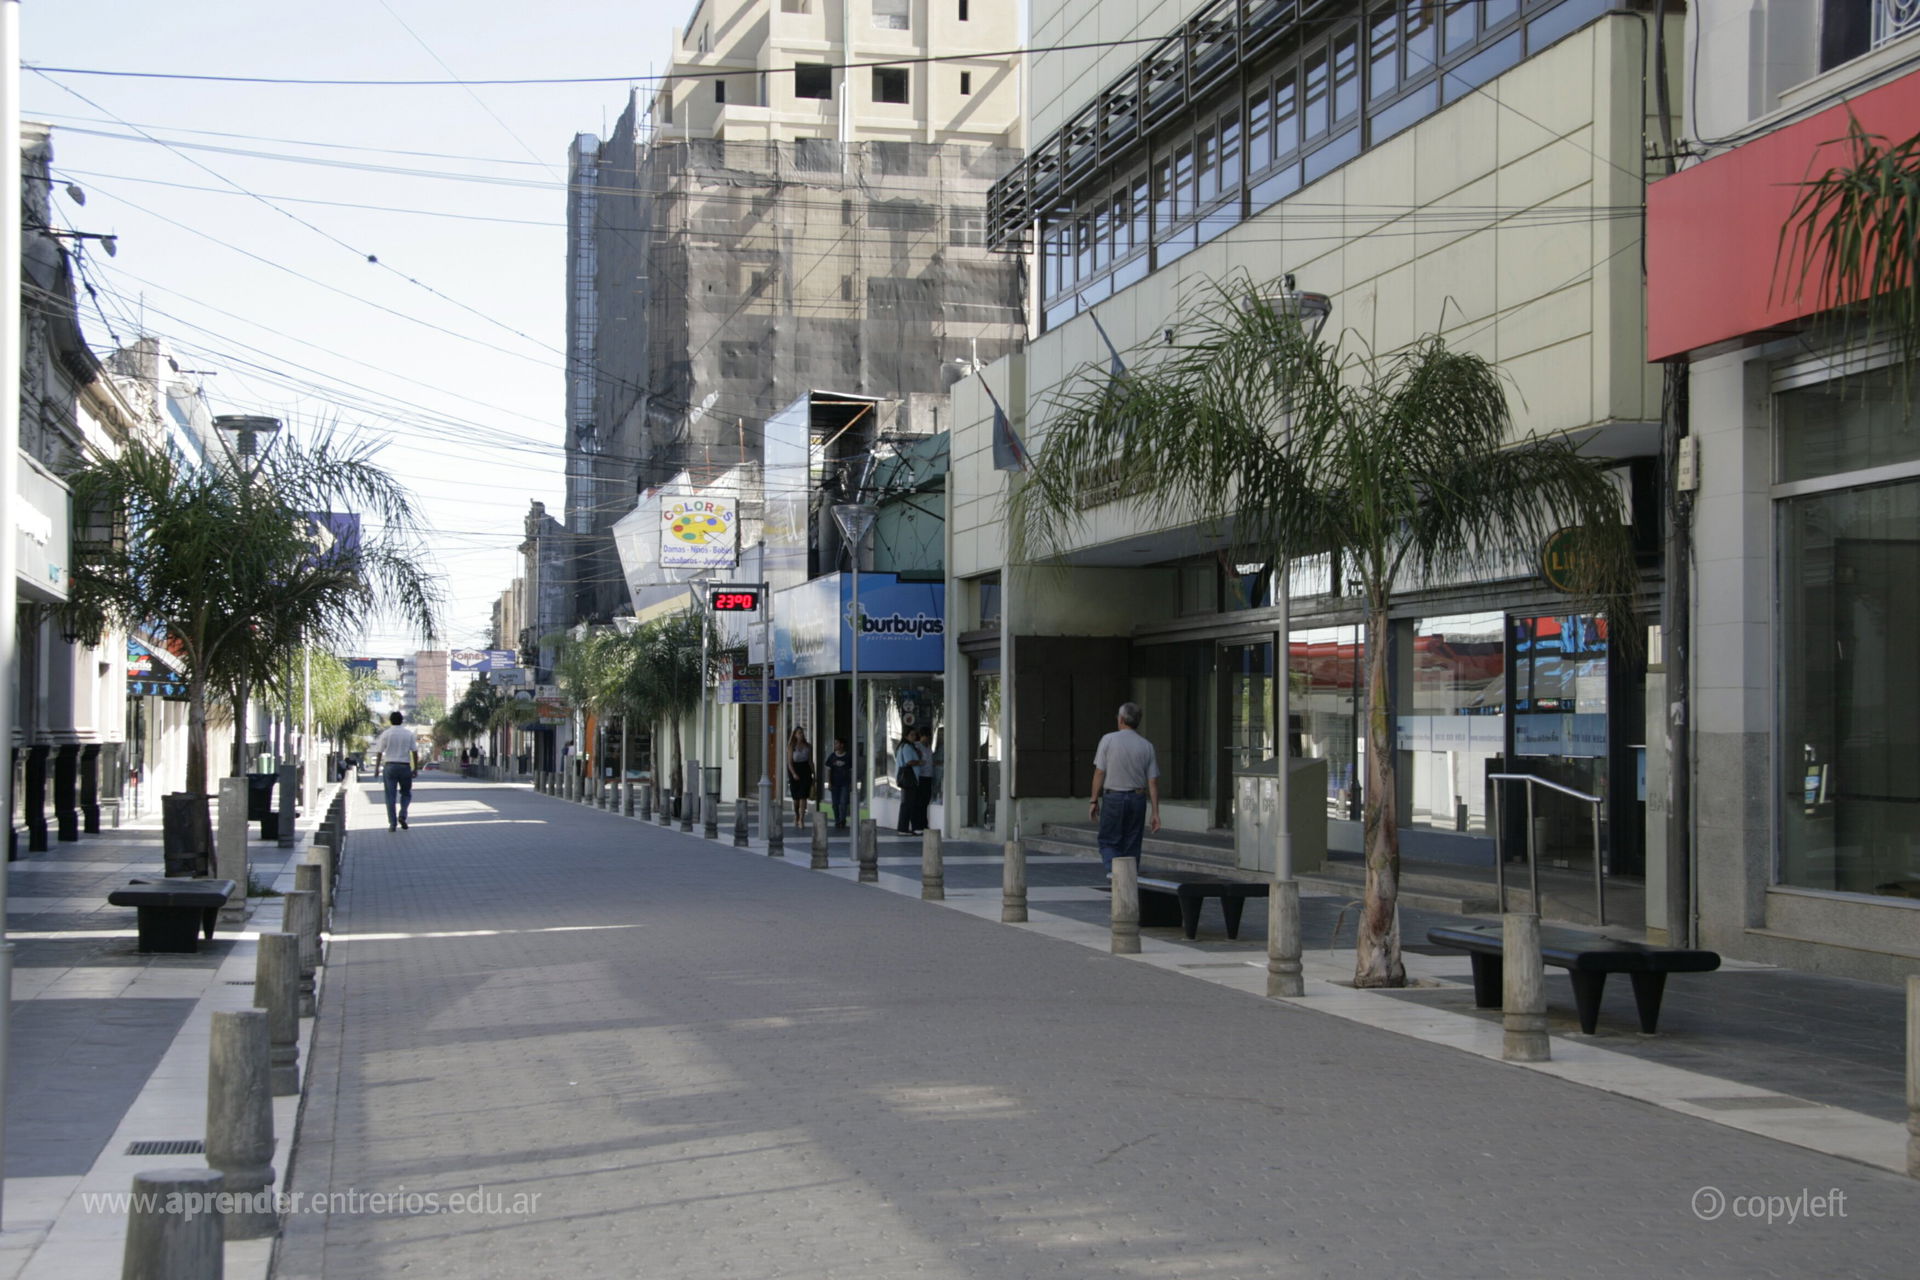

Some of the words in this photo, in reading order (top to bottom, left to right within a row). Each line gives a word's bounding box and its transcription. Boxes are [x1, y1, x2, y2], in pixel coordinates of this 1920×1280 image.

[663, 500, 734, 522] COLORES
[663, 545, 686, 553] Damas
[663, 556, 698, 565] Caballeros
[861, 613, 945, 639] burbujas
